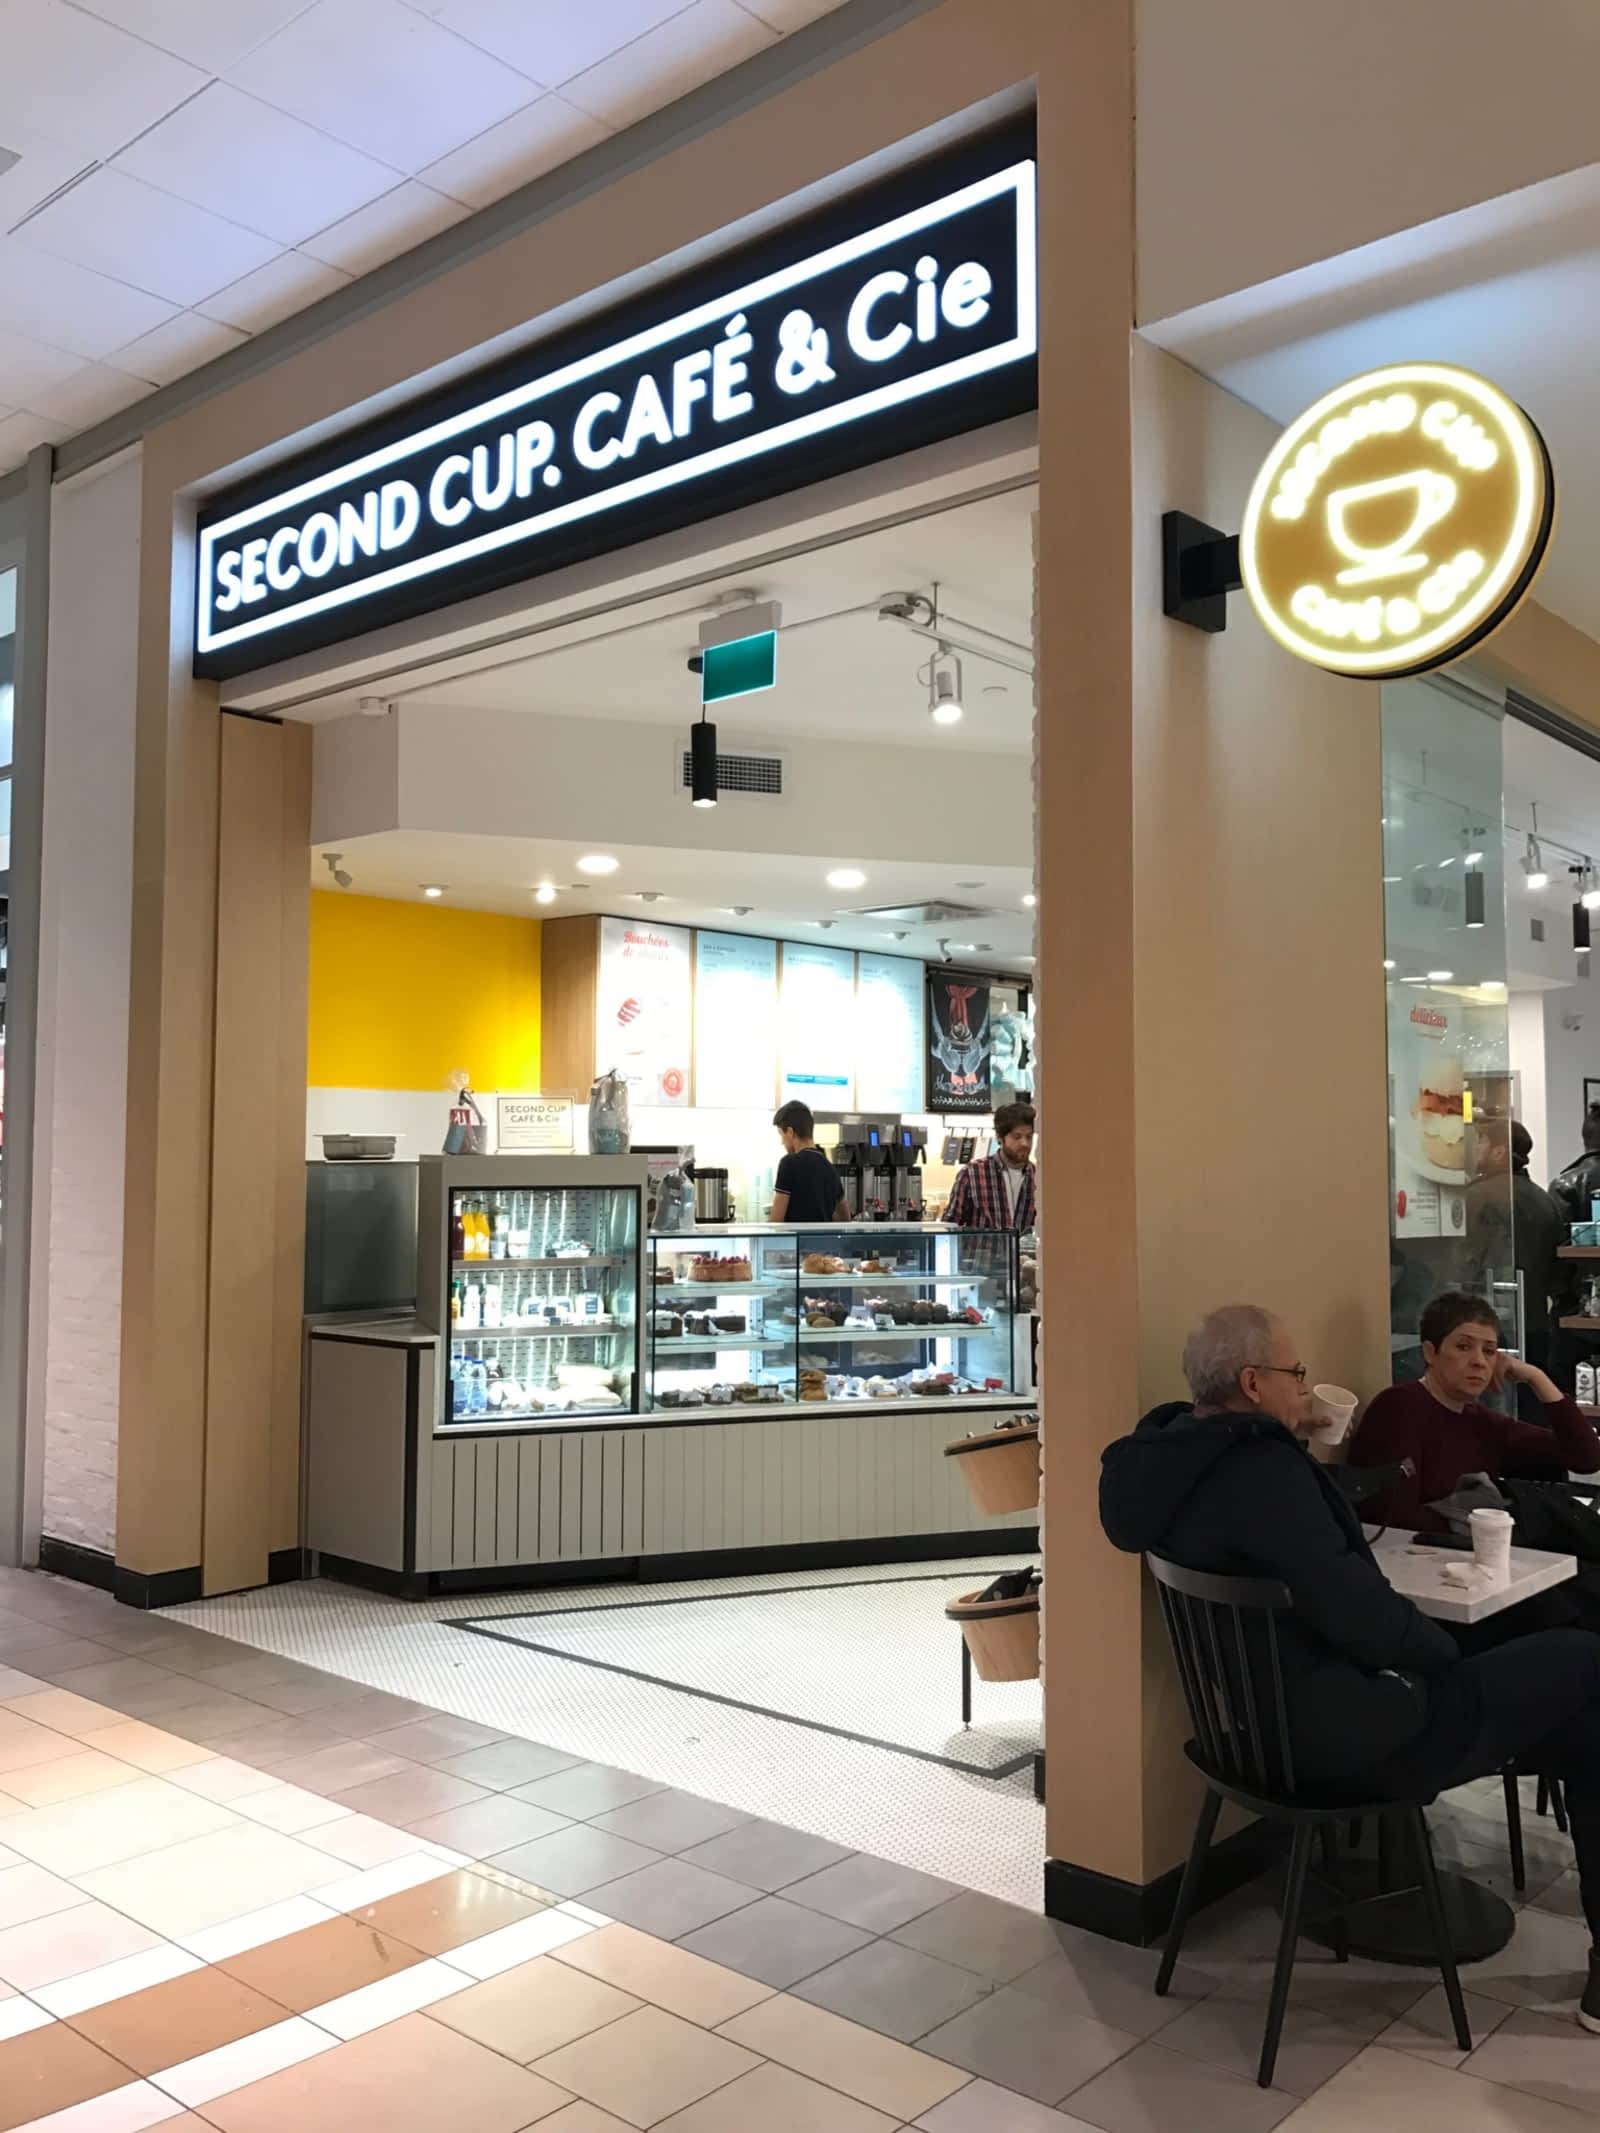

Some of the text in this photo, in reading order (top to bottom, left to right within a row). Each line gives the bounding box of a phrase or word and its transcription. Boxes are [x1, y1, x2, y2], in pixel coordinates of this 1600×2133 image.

[214, 479, 421, 612] SECOND
[572, 312, 753, 470] CAFÉ
[774, 309, 836, 395] &
[847, 255, 992, 362] Cie
[504, 1105, 567, 1113] SECOND CUP
